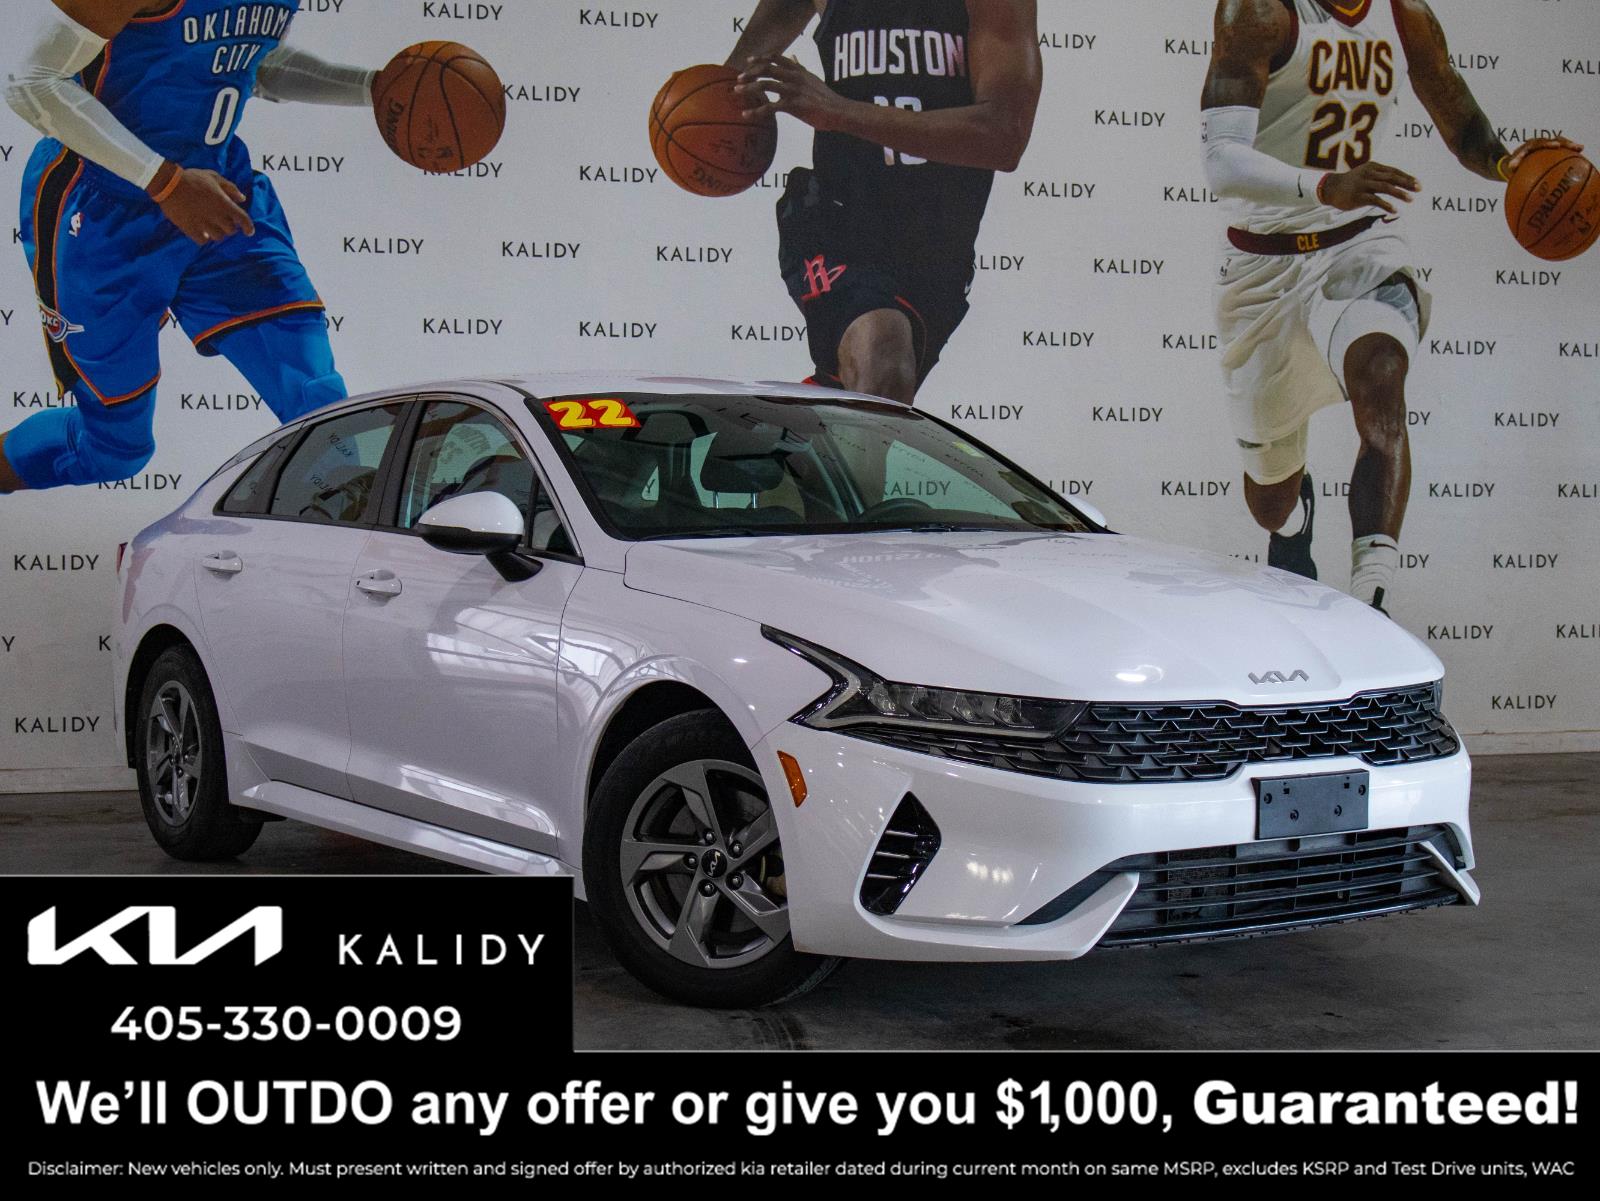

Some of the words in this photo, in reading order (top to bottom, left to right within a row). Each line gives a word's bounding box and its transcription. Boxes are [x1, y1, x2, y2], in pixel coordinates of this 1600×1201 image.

[424, 2, 503, 20] KALIDY
[580, 9, 658, 28] KALIDY
[183, 6, 290, 43] OKLAHOM
[1039, 33, 1096, 49] ALIDY
[1165, 39, 1216, 55] KALI
[212, 43, 261, 74] CITY
[834, 28, 966, 82] HOUSTON
[1448, 54, 1499, 70] ALIDY
[1307, 40, 1394, 96] CAVS
[1562, 59, 1600, 75] KALI
[502, 84, 580, 102] KALIDY
[204, 87, 240, 146] 0
[1095, 110, 1165, 127] KALIDY
[1304, 100, 1381, 170] 23
[263, 155, 344, 172] KALIDY
[580, 165, 658, 183] KALIDY
[1024, 182, 1095, 198] KALIDY
[1432, 197, 1498, 212] KALIDY
[344, 237, 424, 254] KALIDY
[502, 241, 580, 258] KALIDY
[1296, 234, 1320, 251] CLE
[657, 246, 732, 263] KALIDY
[973, 255, 1024, 270] LIDY
[1094, 258, 1164, 274] KALIDY
[1497, 270, 1561, 285] KALIDY
[424, 318, 502, 335] KALIDY
[580, 321, 657, 338] KALIDY
[731, 324, 806, 341] KALIDY
[1024, 331, 1094, 347] KALIDY
[1162, 334, 1217, 350] KALID
[1431, 340, 1496, 355] KALIDY
[1559, 343, 1599, 357] KALI
[181, 394, 262, 410] KALIDY
[549, 399, 636, 428] 22
[952, 405, 1023, 420] KALIDY
[1093, 407, 1163, 422] KALIDY
[1495, 413, 1559, 427] KALIDY
[884, 481, 951, 496] ALIDY
[1162, 481, 1230, 496] KALIDY
[1323, 482, 1351, 496] LID
[1430, 483, 1494, 497] KALIDY
[1558, 484, 1597, 498] KALI
[14, 555, 99, 571] KALIDY
[1400, 554, 1429, 568] IDY
[1494, 554, 1558, 568] KALIDY
[1428, 625, 1493, 639] KALIDY
[1556, 625, 1600, 639] KALI
[1492, 695, 1556, 709] KALIDY
[15, 716, 99, 733] KALIDY
